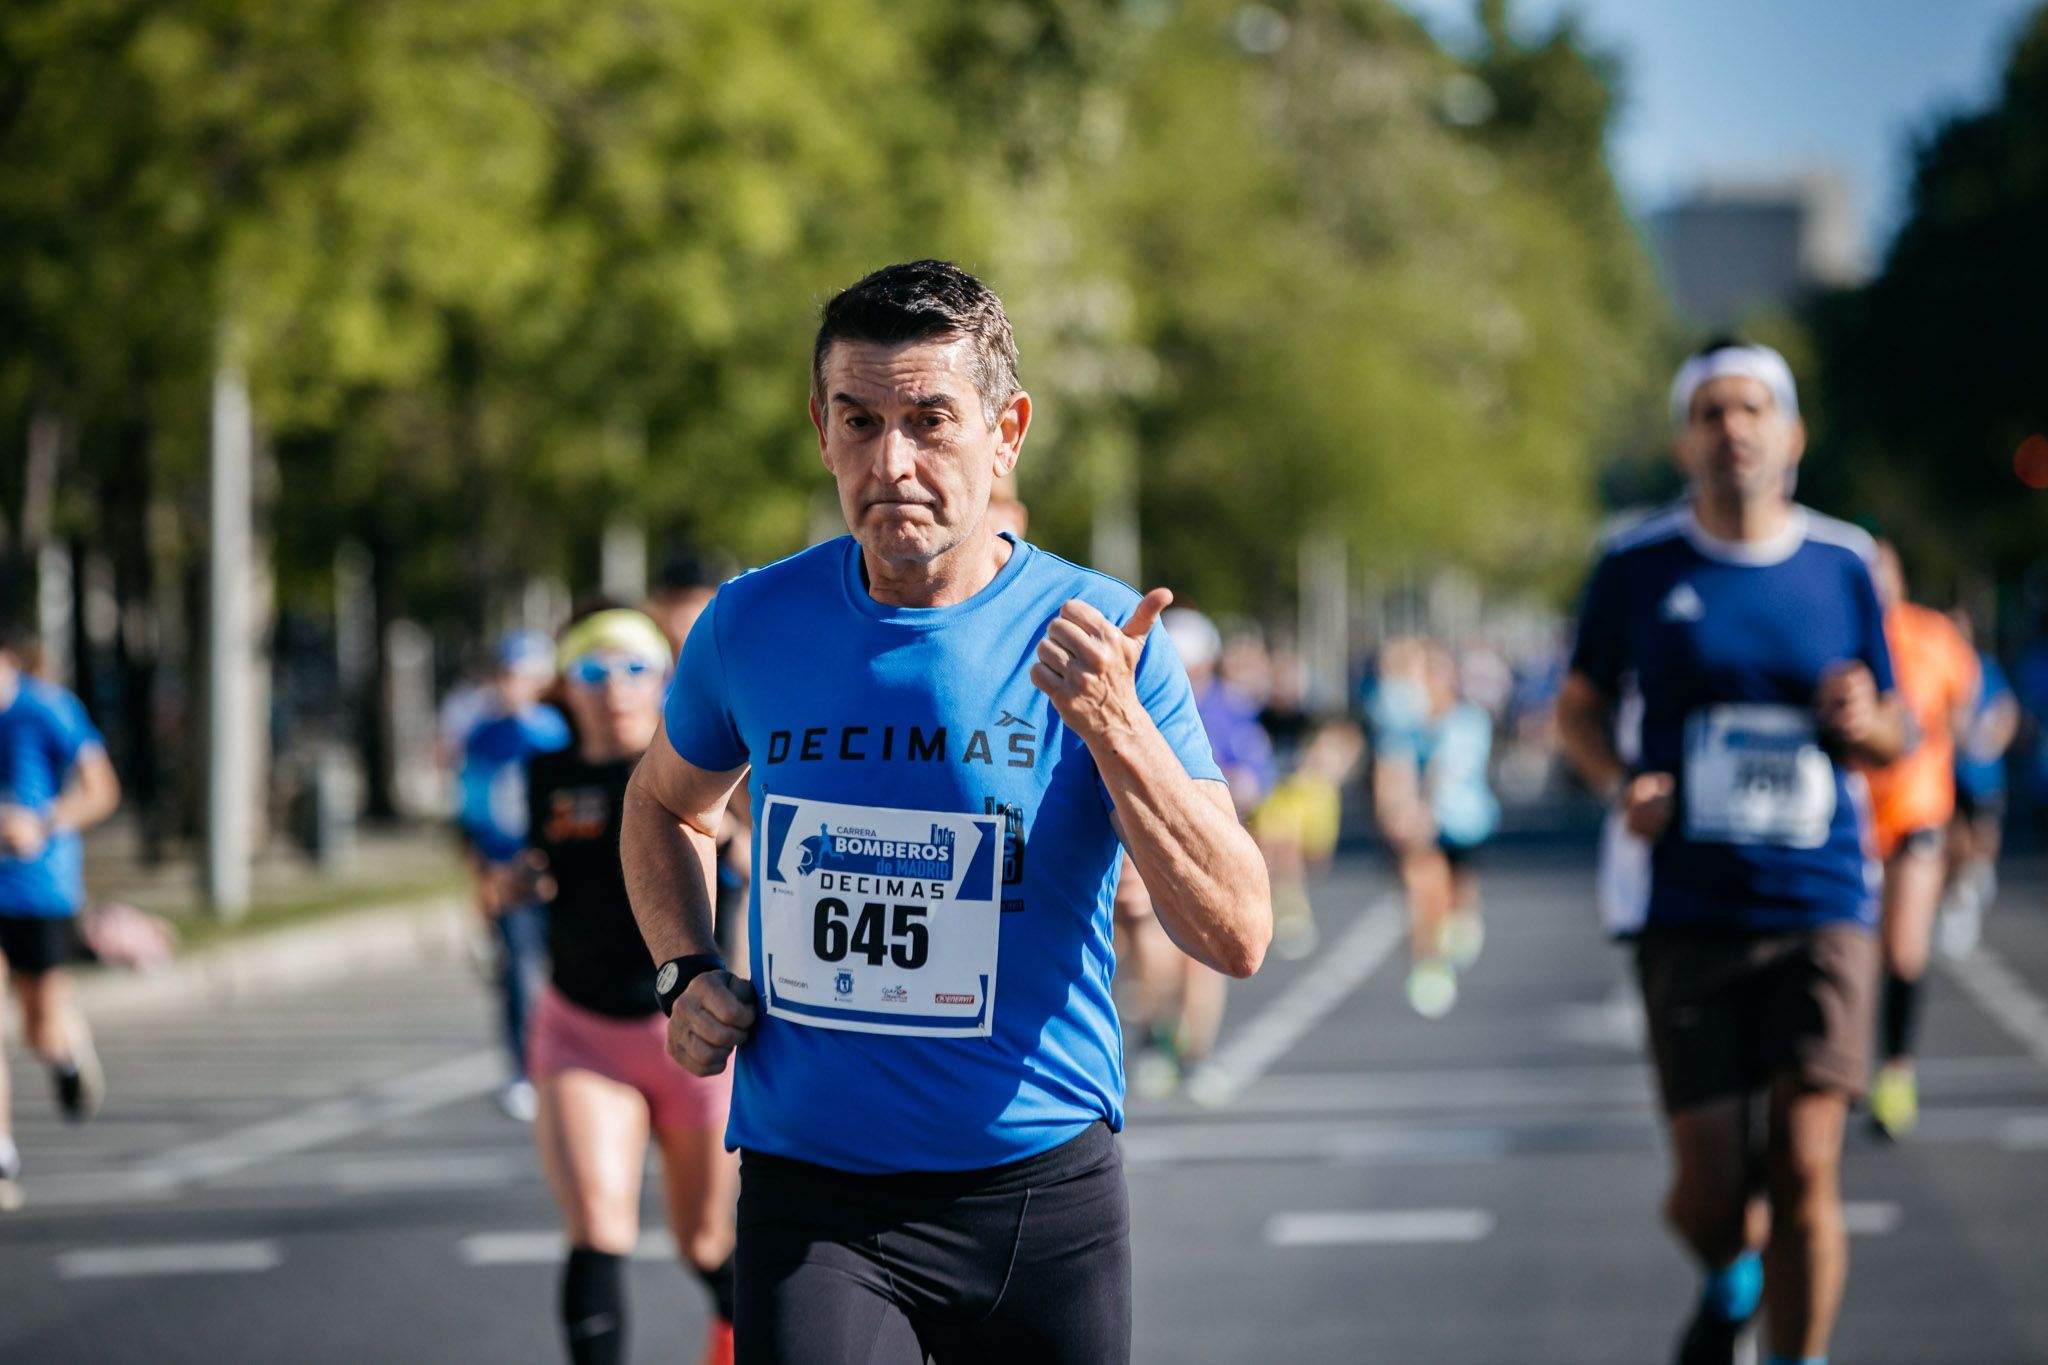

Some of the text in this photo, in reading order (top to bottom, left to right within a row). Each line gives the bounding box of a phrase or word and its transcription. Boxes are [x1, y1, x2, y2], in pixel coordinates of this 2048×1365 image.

[767, 726, 1036, 768] DECIMAS
[837, 826, 877, 837] CARRERA
[835, 837, 950, 861] BOMBEROS
[876, 858, 950, 879] de MADRID
[820, 873, 945, 899] DECIMAS
[813, 897, 929, 969] 645
